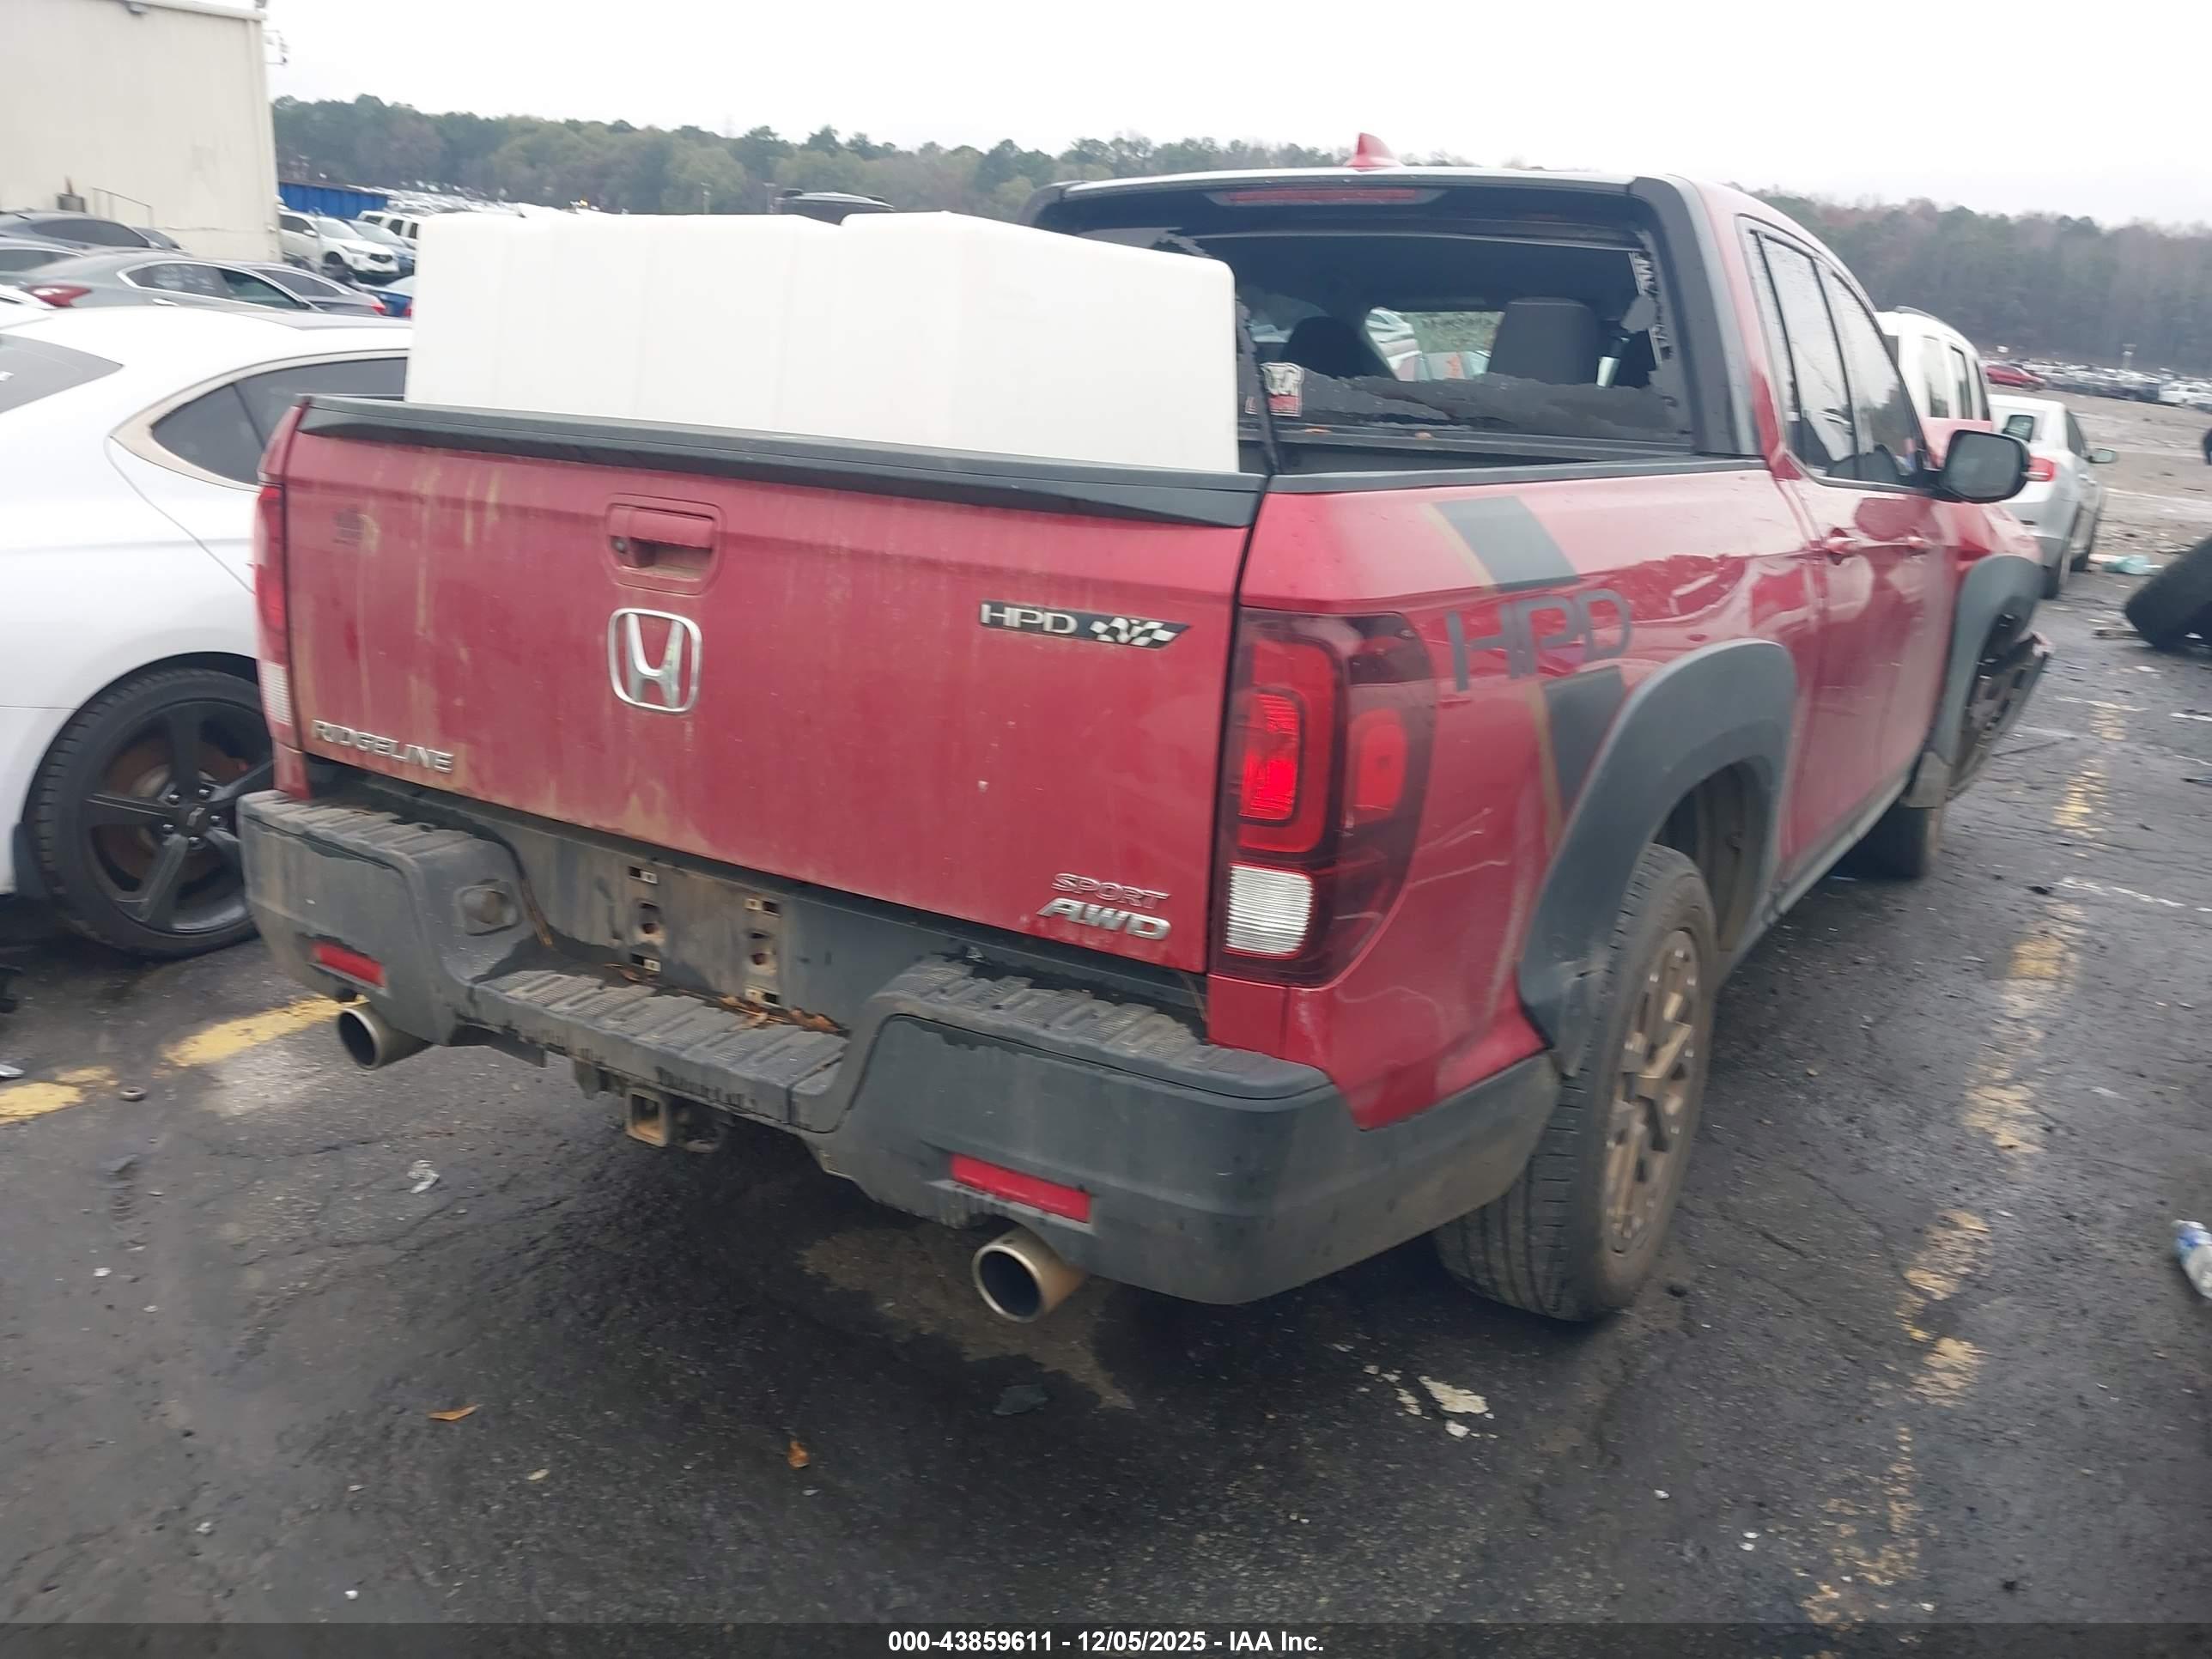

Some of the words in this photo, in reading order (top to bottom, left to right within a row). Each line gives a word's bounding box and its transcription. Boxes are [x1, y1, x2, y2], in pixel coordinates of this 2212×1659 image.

[981, 604, 1078, 634] HPD
[1446, 589, 1632, 691] HPD
[312, 720, 454, 774] RIDGELINE
[1051, 872, 1170, 908] SPORT
[1036, 897, 1172, 940] AWD
